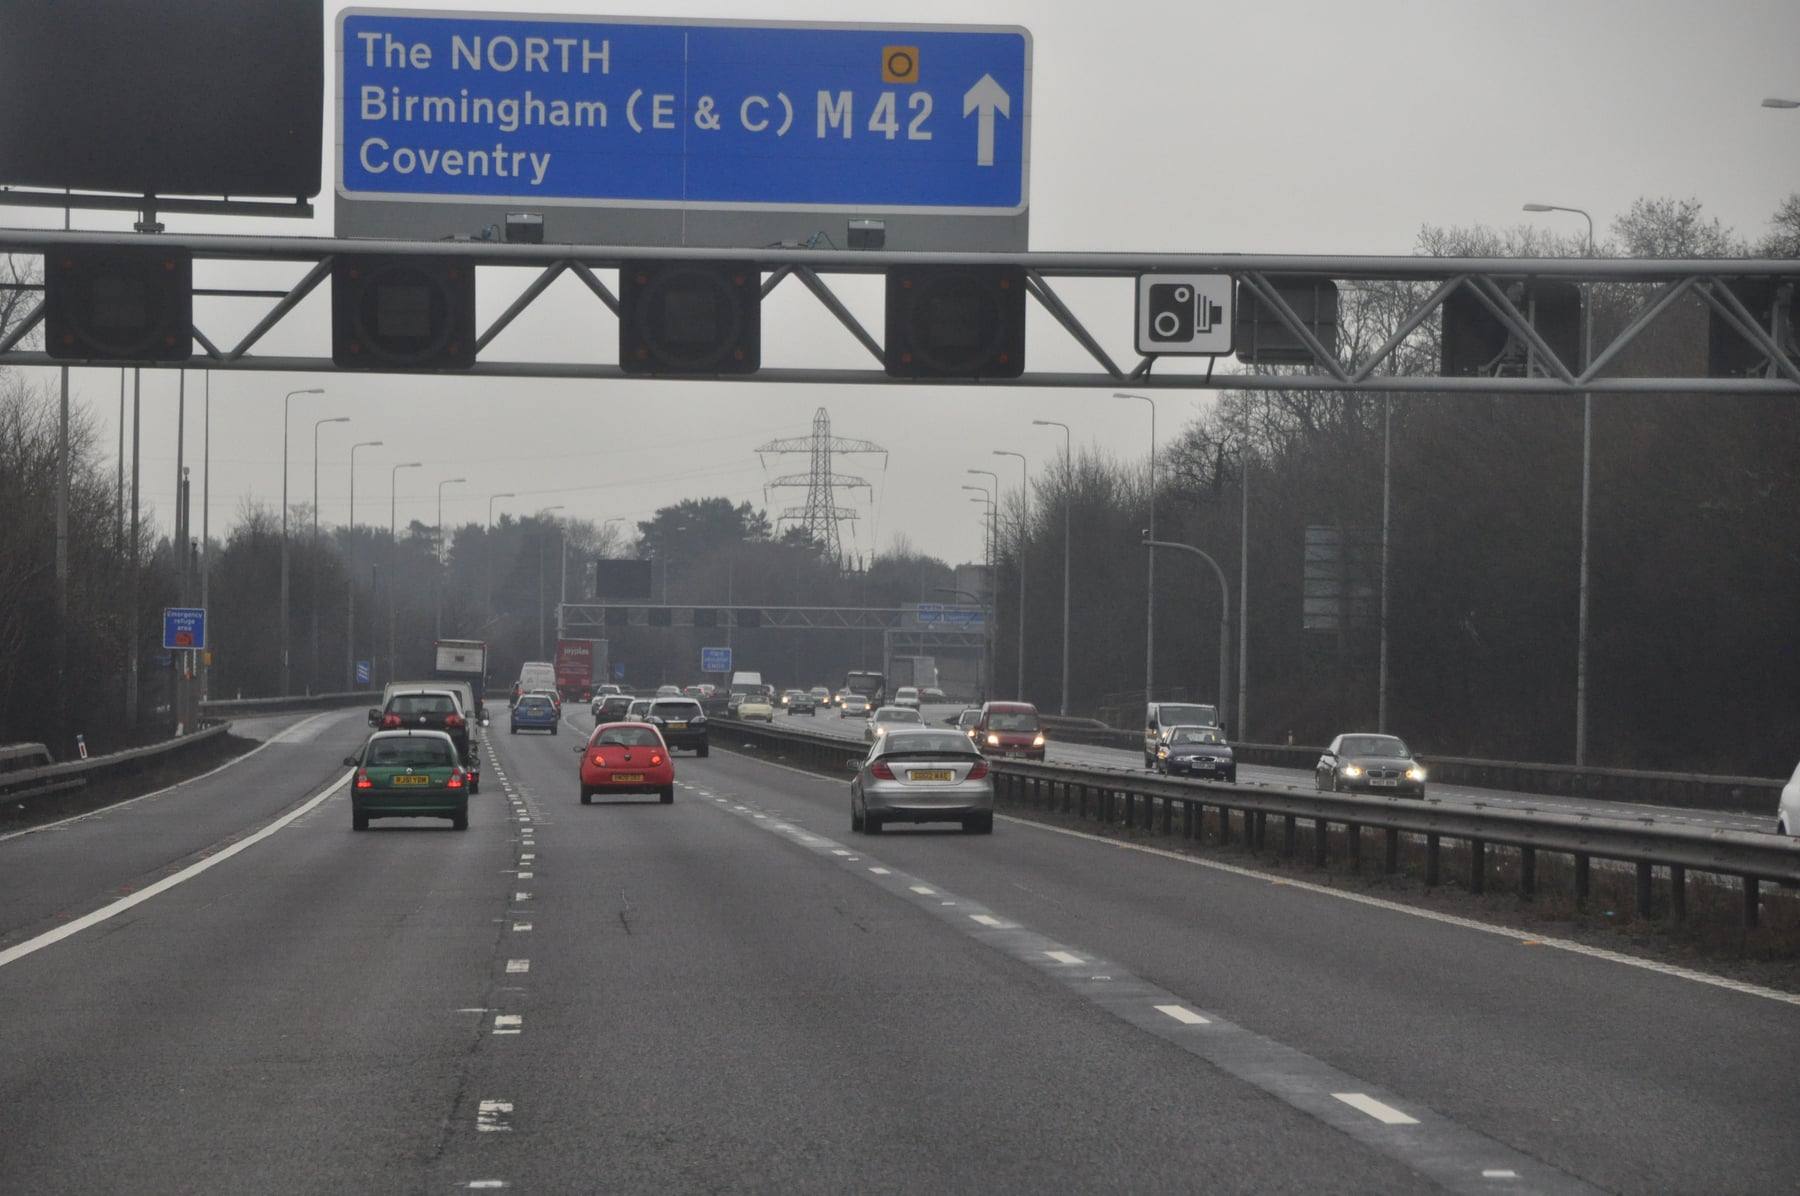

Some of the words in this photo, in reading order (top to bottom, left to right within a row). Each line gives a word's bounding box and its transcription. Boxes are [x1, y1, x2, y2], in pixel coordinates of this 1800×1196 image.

[358, 32, 432, 69] The
[453, 36, 609, 74] NORTH
[362, 86, 607, 132] Birmingham
[695, 96, 721, 129] &
[361, 138, 551, 185] Coventry
[167, 610, 203, 618] Emergency
